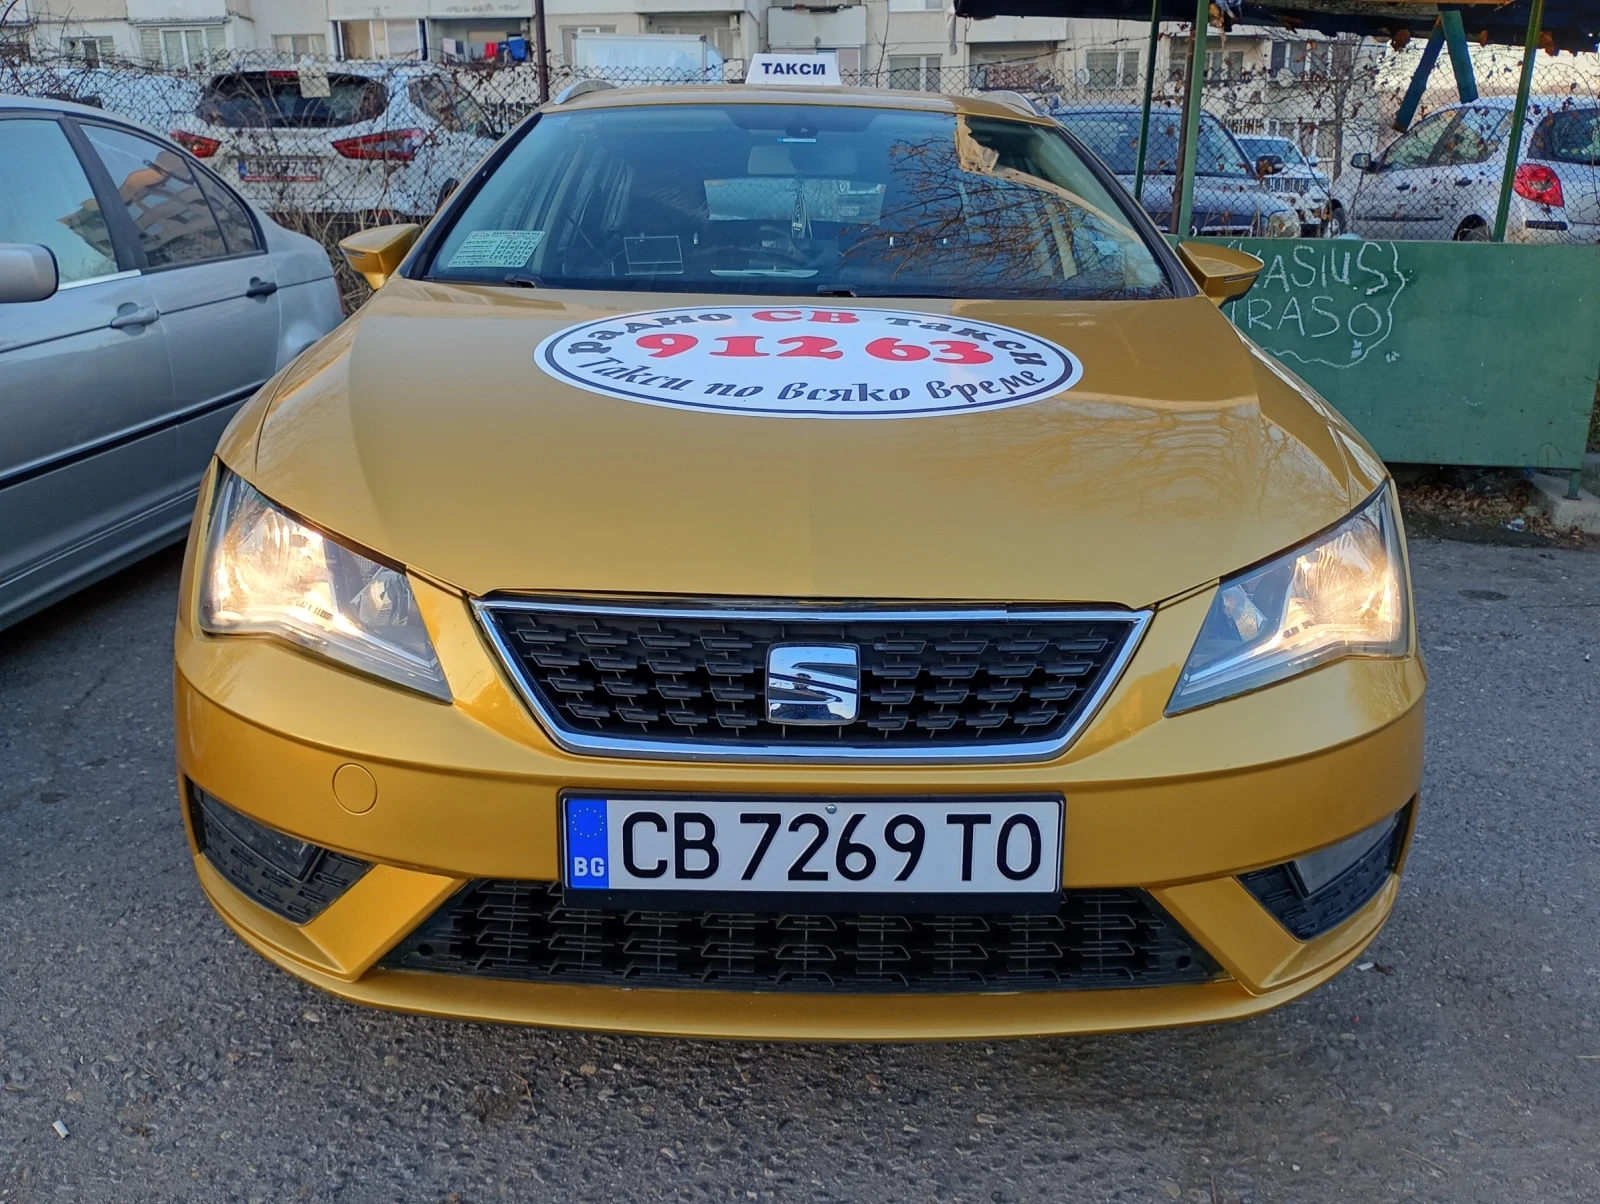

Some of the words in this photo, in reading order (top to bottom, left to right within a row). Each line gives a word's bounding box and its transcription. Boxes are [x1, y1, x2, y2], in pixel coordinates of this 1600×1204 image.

[761, 62, 826, 76] ТАКСИ
[567, 313, 733, 355] радио
[751, 310, 861, 324] СВ
[884, 317, 1048, 367] такси
[576, 356, 694, 391] Такси
[703, 382, 764, 398] по
[776, 381, 911, 403] всяко
[925, 369, 1046, 404] време
[573, 856, 606, 877] BG
[622, 811, 720, 880] CB
[739, 812, 926, 882] 7269
